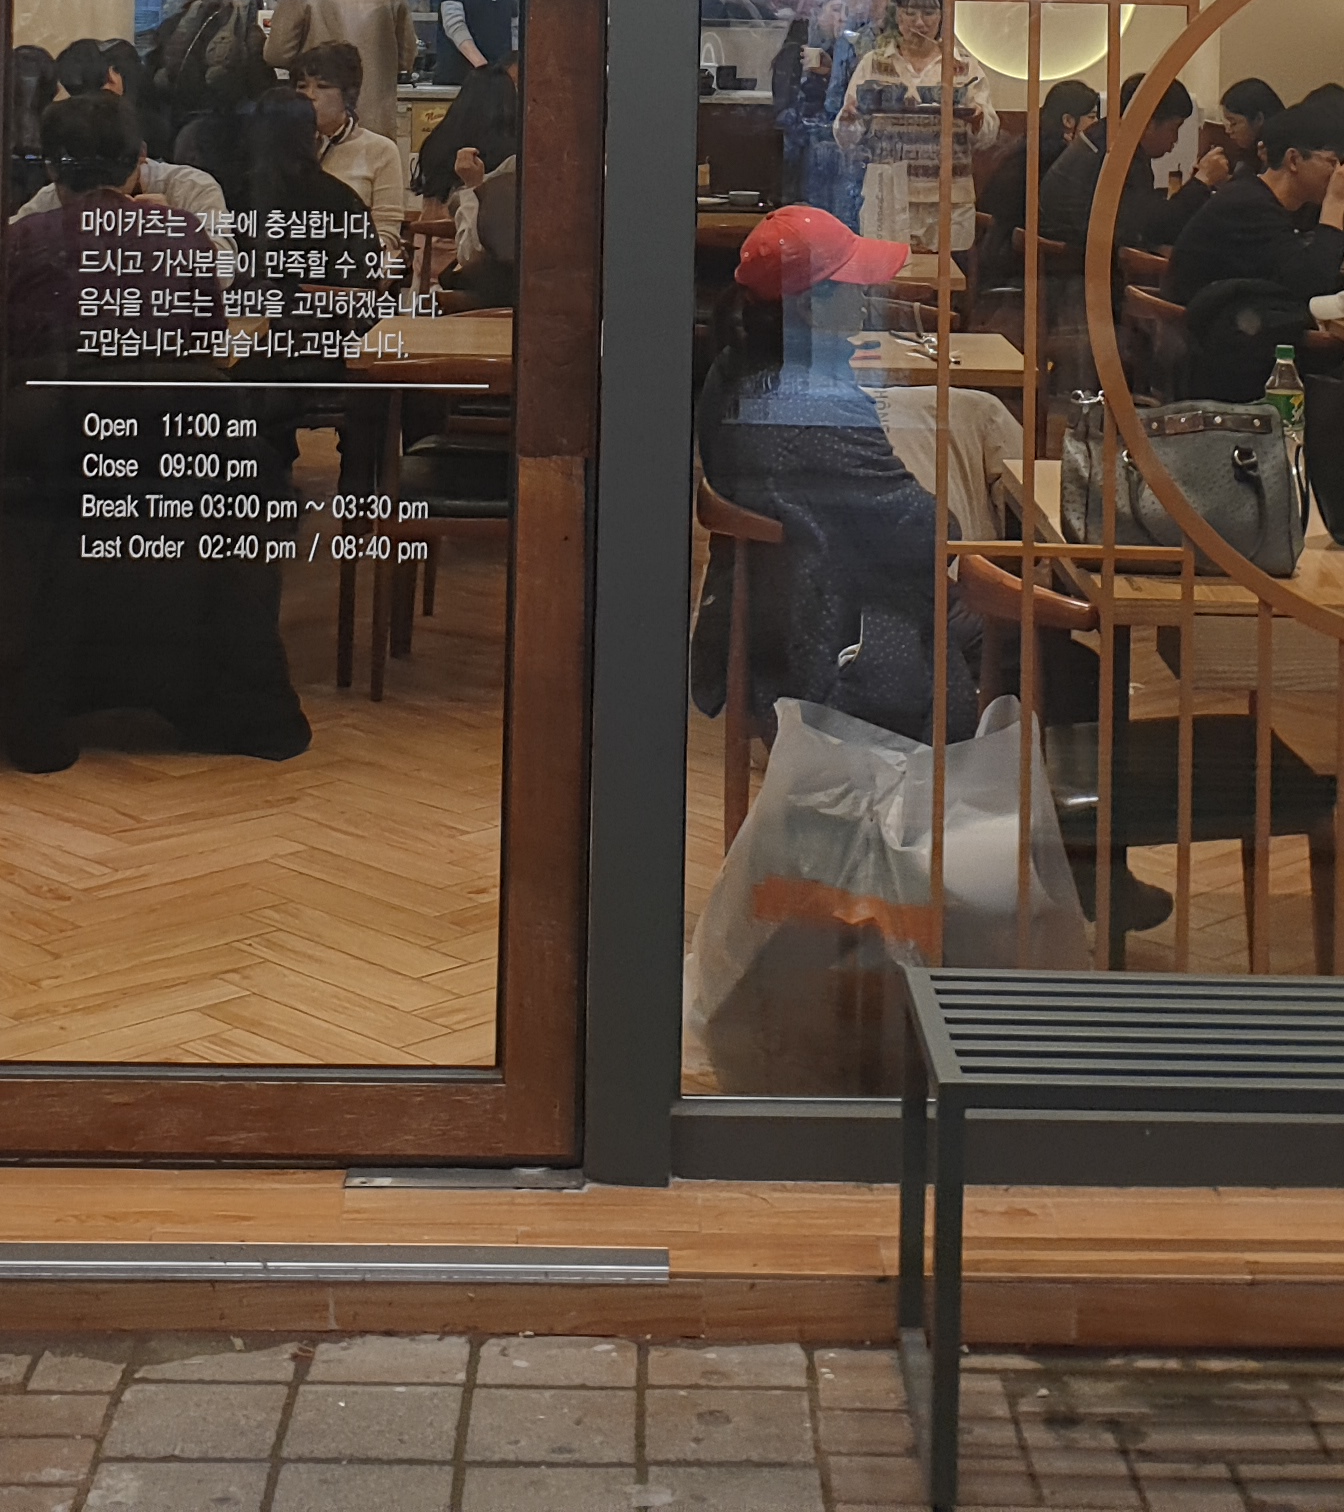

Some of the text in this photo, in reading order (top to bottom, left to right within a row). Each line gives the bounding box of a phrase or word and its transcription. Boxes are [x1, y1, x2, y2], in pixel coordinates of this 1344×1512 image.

[81, 208, 375, 240] 마이카츠는 기본에 충실합니다.
[79, 249, 406, 280] 드시고 가신분들이 만족할 수 있는
[78, 288, 443, 319] 음식을 만드는 법만을 고민하겠습니다.
[84, 413, 257, 440] Open 11:00 am
[83, 453, 257, 481] Close 09:00 pm
[82, 495, 139, 518] Break
[146, 495, 193, 519] Time
[200, 495, 259, 519] 03:00
[266, 501, 298, 522] pm
[332, 496, 391, 520] 03:30
[398, 501, 429, 522] pm
[80, 533, 428, 563] Last Order 02:40 pm / 08:40 pm
